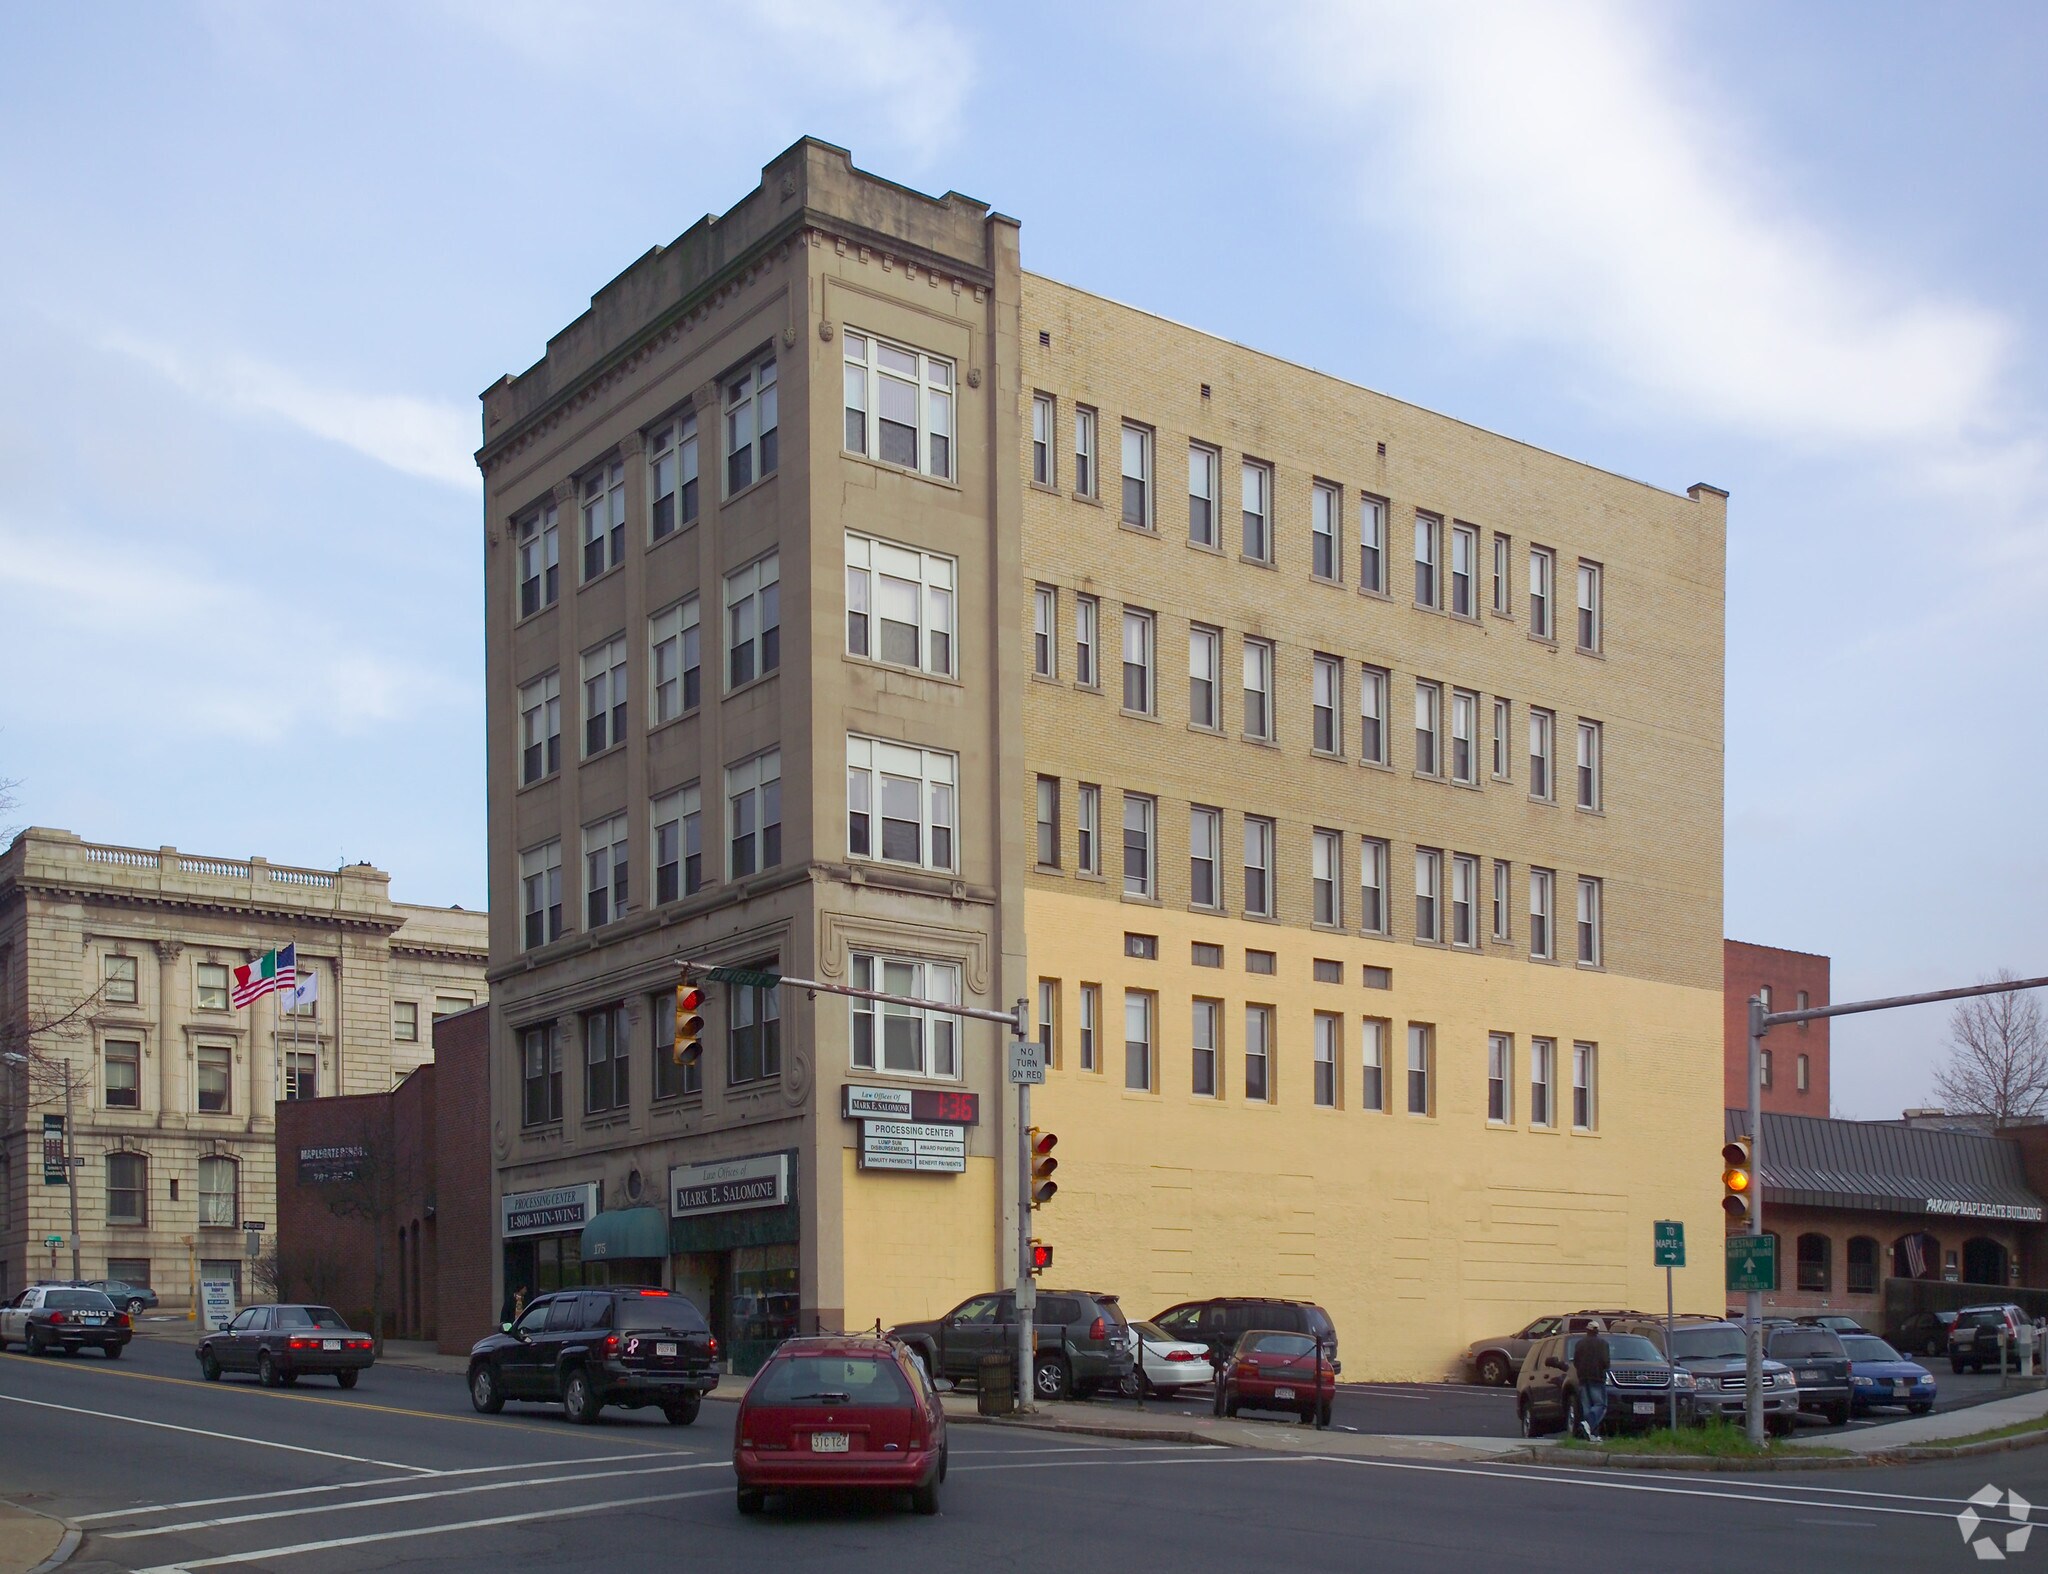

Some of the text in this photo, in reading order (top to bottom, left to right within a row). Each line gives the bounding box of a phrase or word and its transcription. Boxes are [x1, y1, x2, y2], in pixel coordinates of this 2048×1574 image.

[1021, 1048, 1034, 1056] NO
[1017, 1059, 1038, 1067] TURN
[1012, 1070, 1042, 1079] ON RED
[873, 1092, 892, 1100] Offices
[852, 1100, 909, 1113] MARK E. SALOMONE
[938, 1092, 973, 1121] 1:36
[875, 1124, 954, 1138] PROCESSING CENTER
[870, 1144, 910, 1152] DISBURSEMENTS
[703, 1169, 716, 1180] Law
[717, 1167, 739, 1179] Offices
[680, 1181, 773, 1207] MARK E. SALOMONE
[514, 1191, 577, 1210] PROCESSING CENTER
[1960, 1201, 2006, 1218] MAPLEGATE
[2006, 1205, 2042, 1220] BUILDING
[510, 1207, 582, 1229] 1-800-WIN-WIN-1
[1665, 1227, 1675, 1236] TO
[593, 1243, 606, 1255] 175
[1655, 1239, 1677, 1249] MAPLE
[1727, 1238, 1772, 1249] CHESTNUT ST
